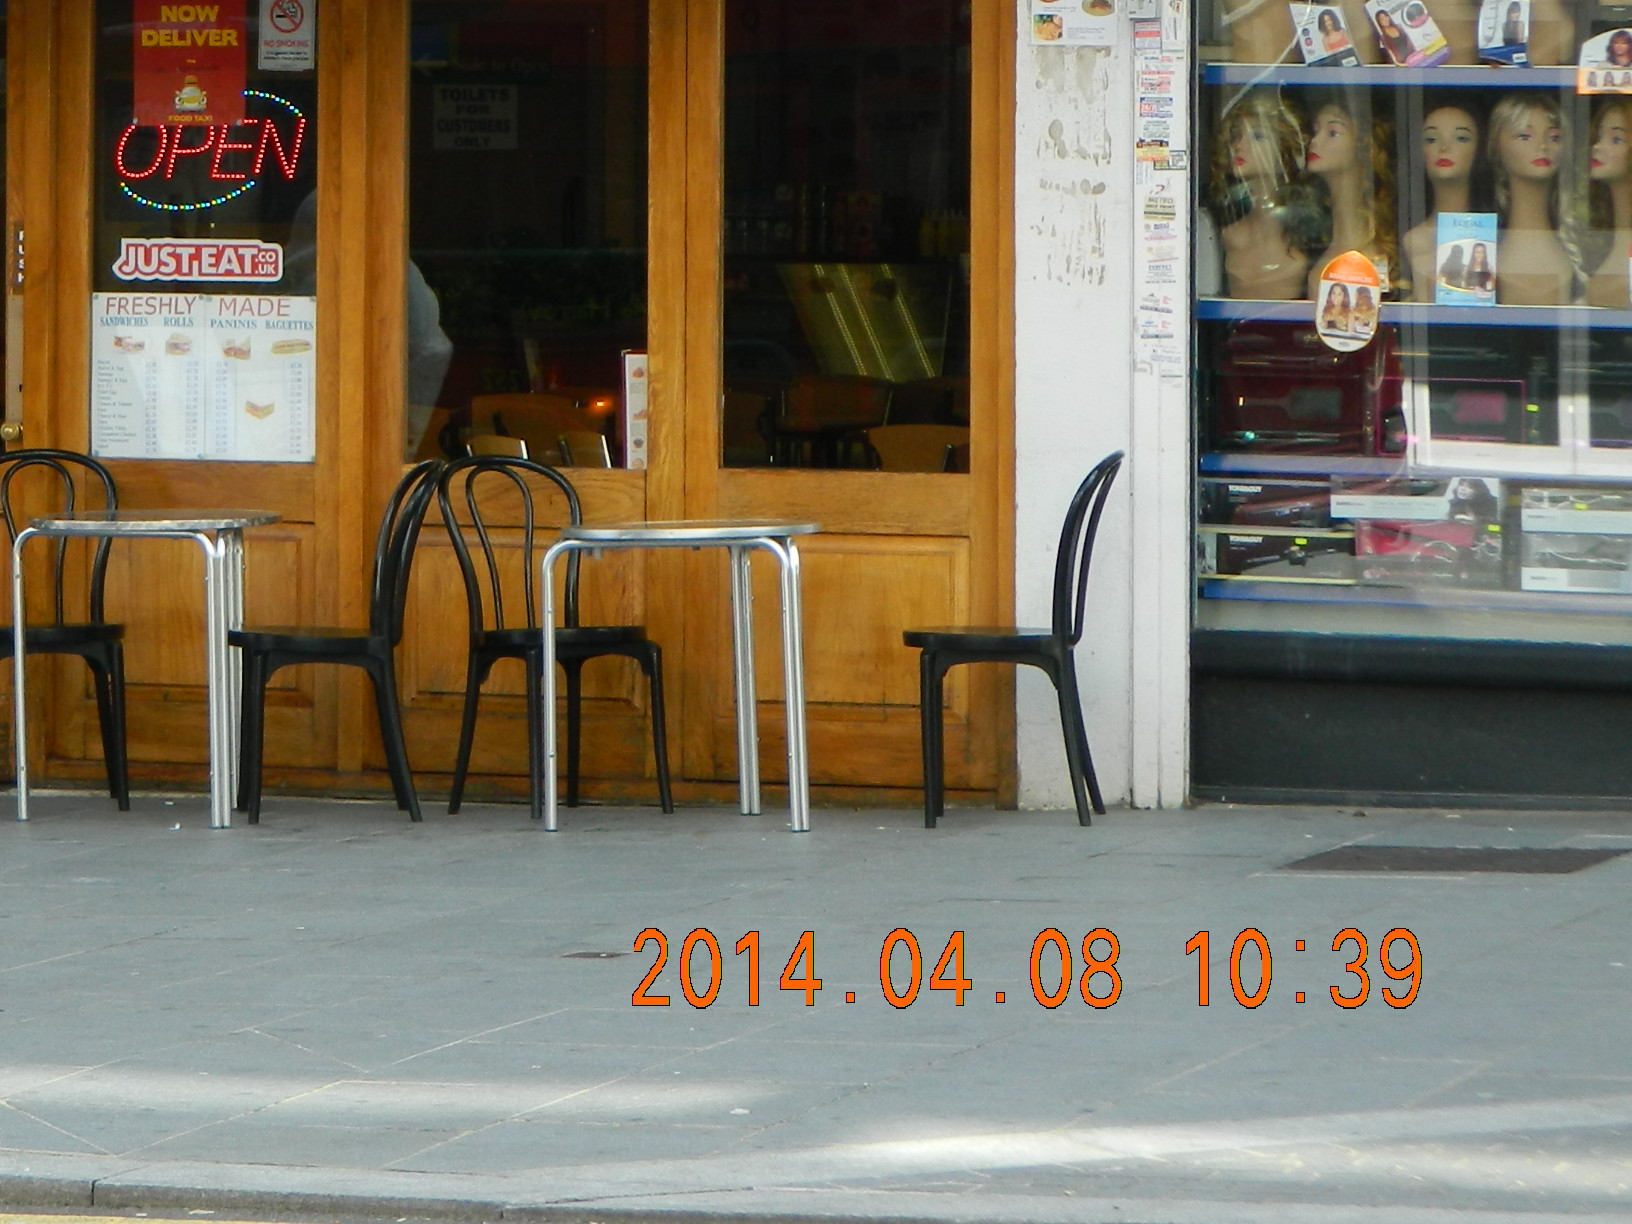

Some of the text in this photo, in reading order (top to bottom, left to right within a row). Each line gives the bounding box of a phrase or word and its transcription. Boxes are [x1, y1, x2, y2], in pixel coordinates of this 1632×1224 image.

[160, 5, 220, 23] NOW
[141, 29, 239, 47] DELIVER
[438, 87, 511, 102] TOILETS
[455, 104, 491, 116] FOR
[436, 118, 512, 134] CUSTOMERS
[115, 116, 308, 182] OPEN
[453, 136, 491, 149] ONLY
[105, 296, 292, 317] FRESHLY MADE
[99, 317, 315, 331] SANDWICHES ROLLS PANINIS BAGUETTES
